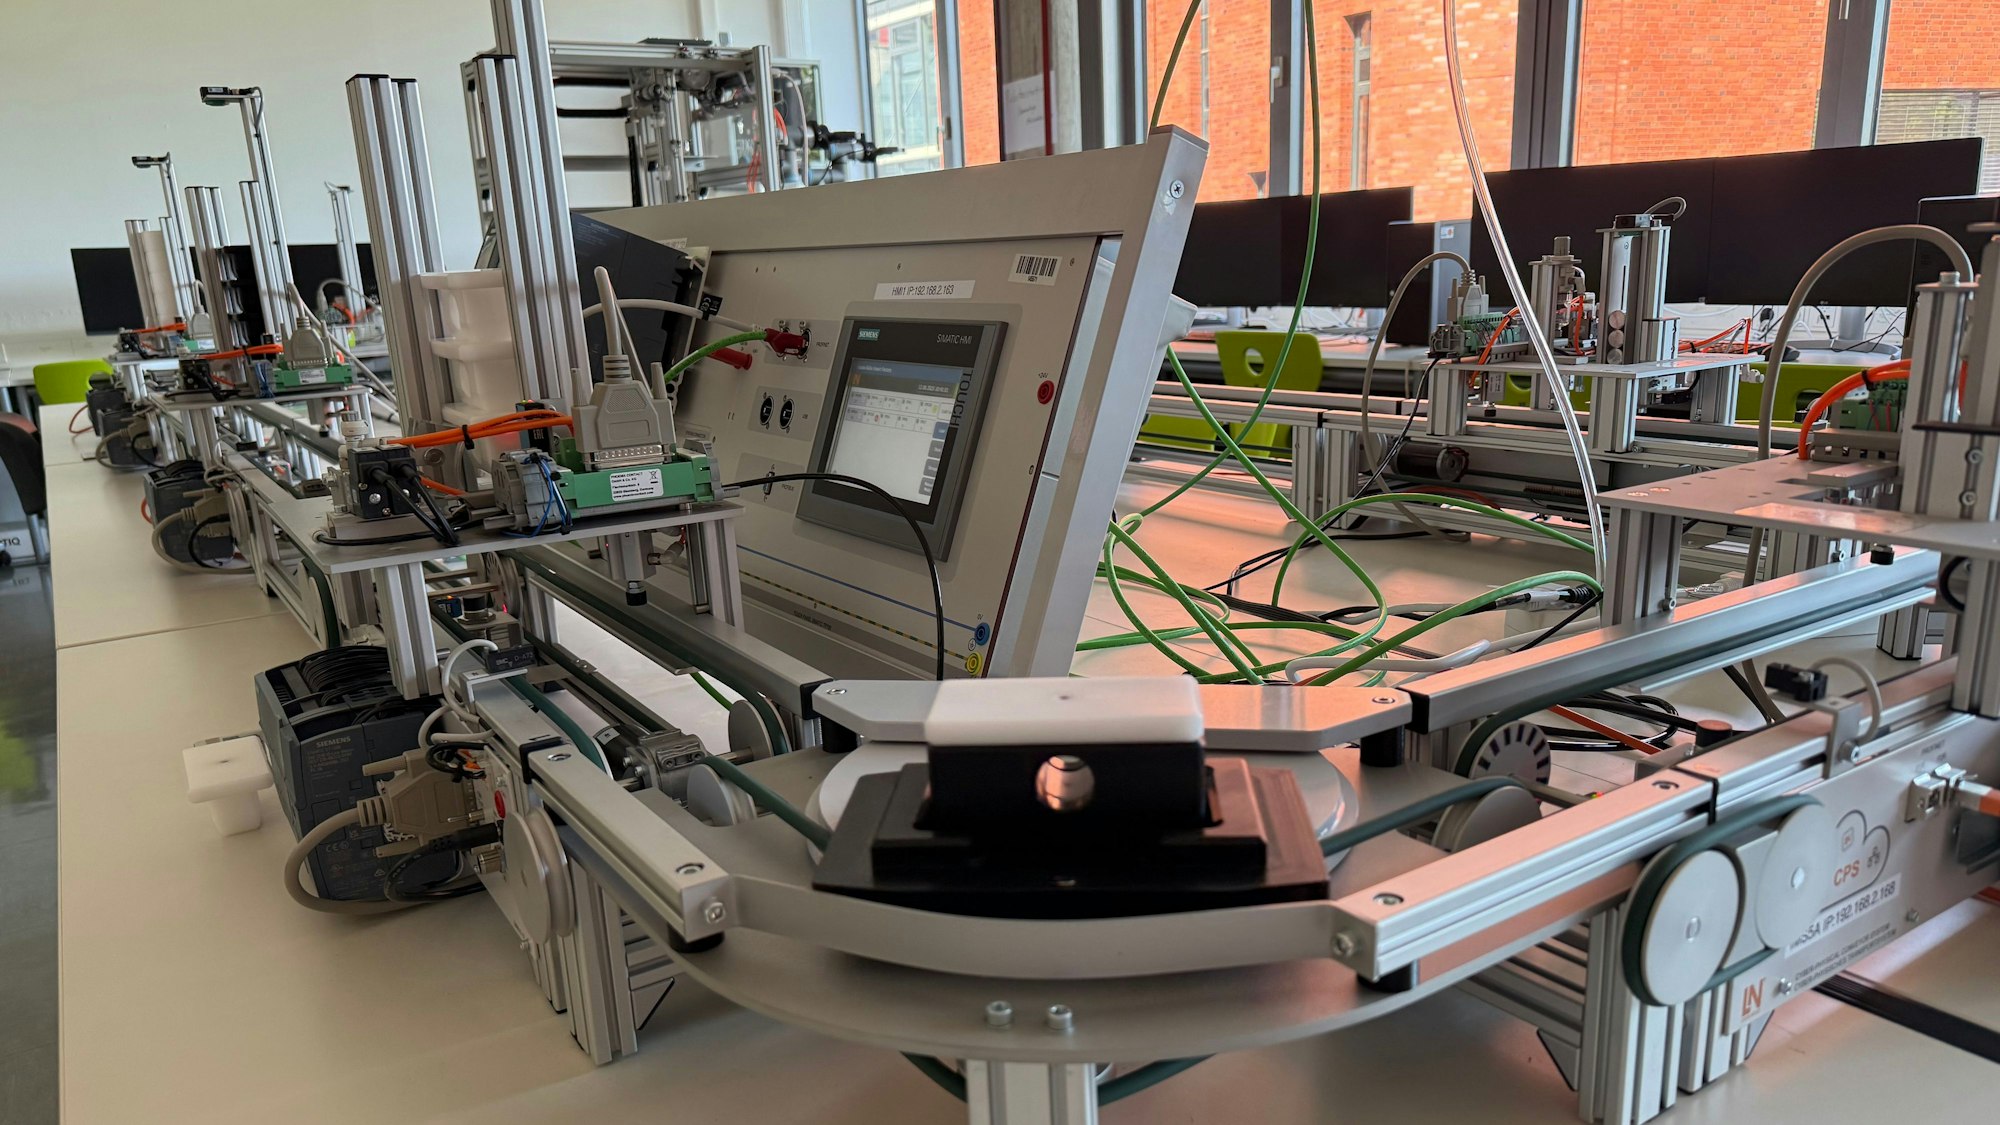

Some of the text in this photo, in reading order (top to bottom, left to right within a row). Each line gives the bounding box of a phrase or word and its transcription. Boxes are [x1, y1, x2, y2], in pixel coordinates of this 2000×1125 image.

[858, 330, 880, 340] SIEMENS
[936, 333, 974, 345] SIMATIC HMI
[949, 369, 974, 427] TOUCH
[315, 736, 353, 750] SIEMENS
[1833, 859, 1860, 887] CPS
